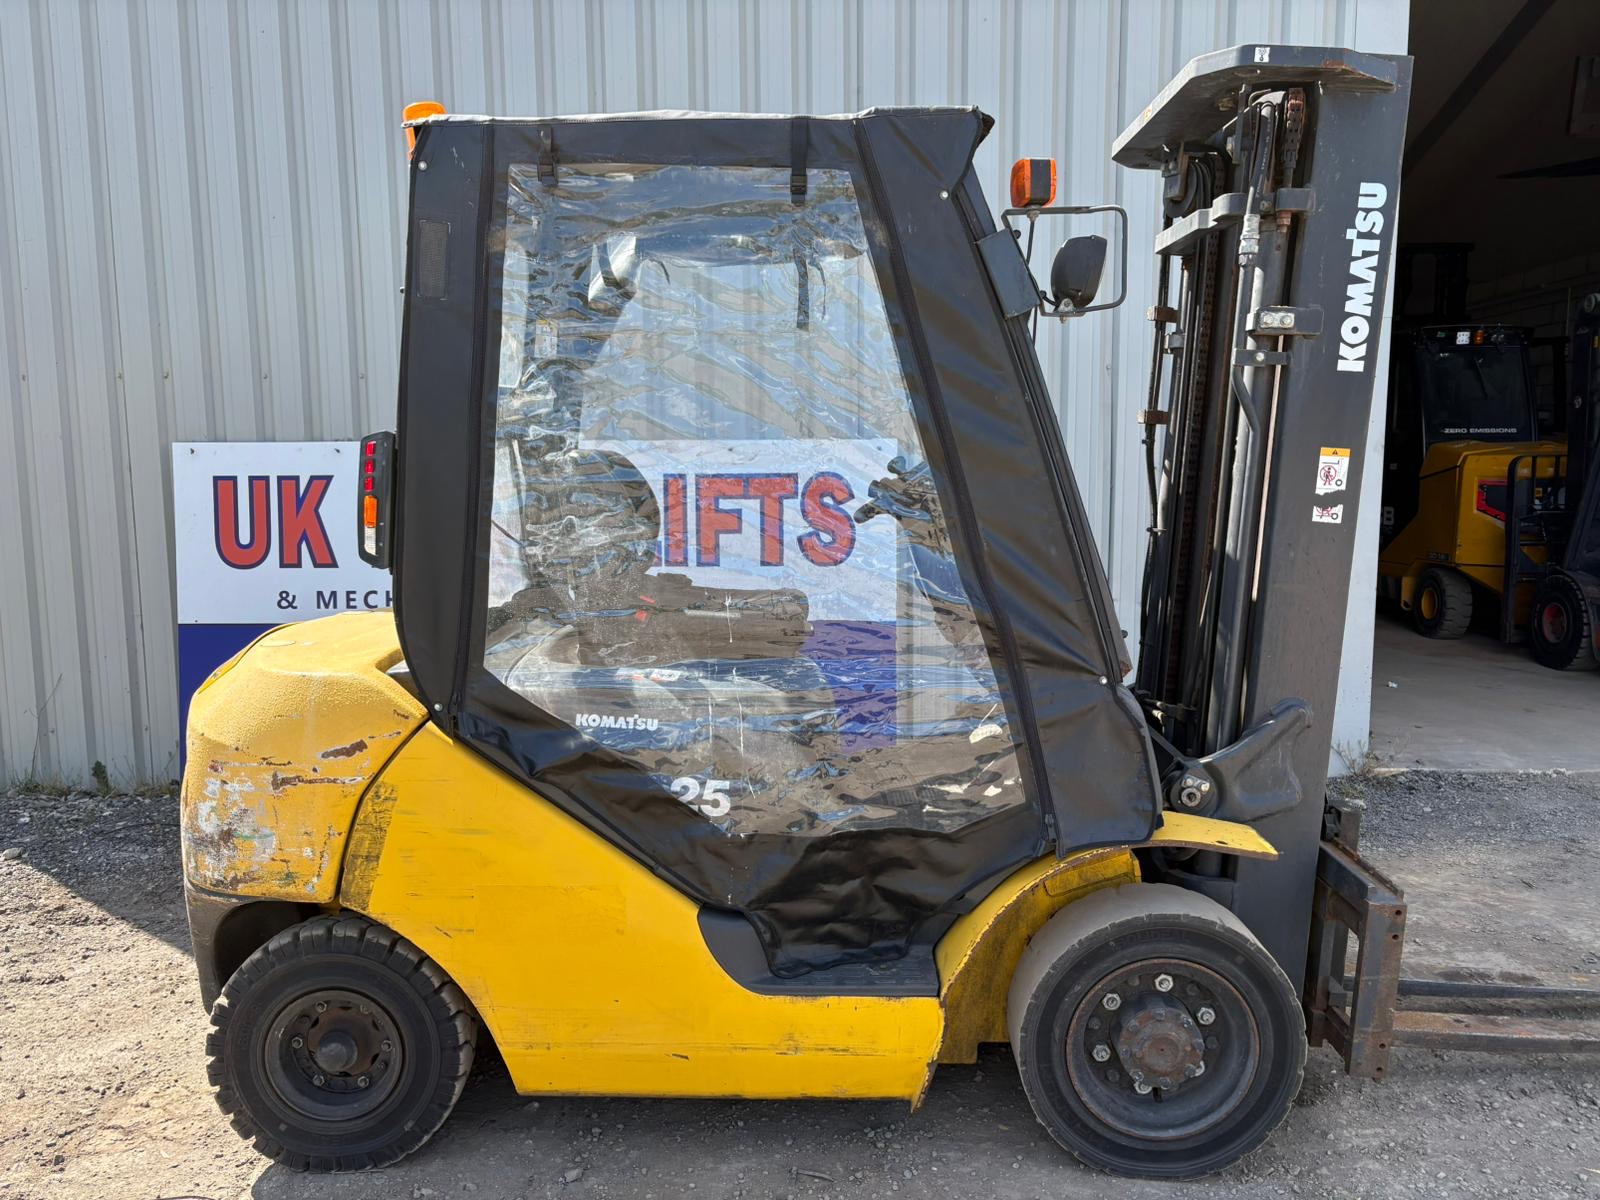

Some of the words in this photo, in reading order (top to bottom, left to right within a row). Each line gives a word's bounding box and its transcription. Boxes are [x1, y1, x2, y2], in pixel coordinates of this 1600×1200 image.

[1337, 182, 1388, 372] KOMATSU
[213, 475, 339, 570] UK
[653, 471, 856, 567] IFTS
[277, 590, 298, 610] &
[575, 713, 659, 731] KOMATSU
[670, 777, 731, 817] 25
